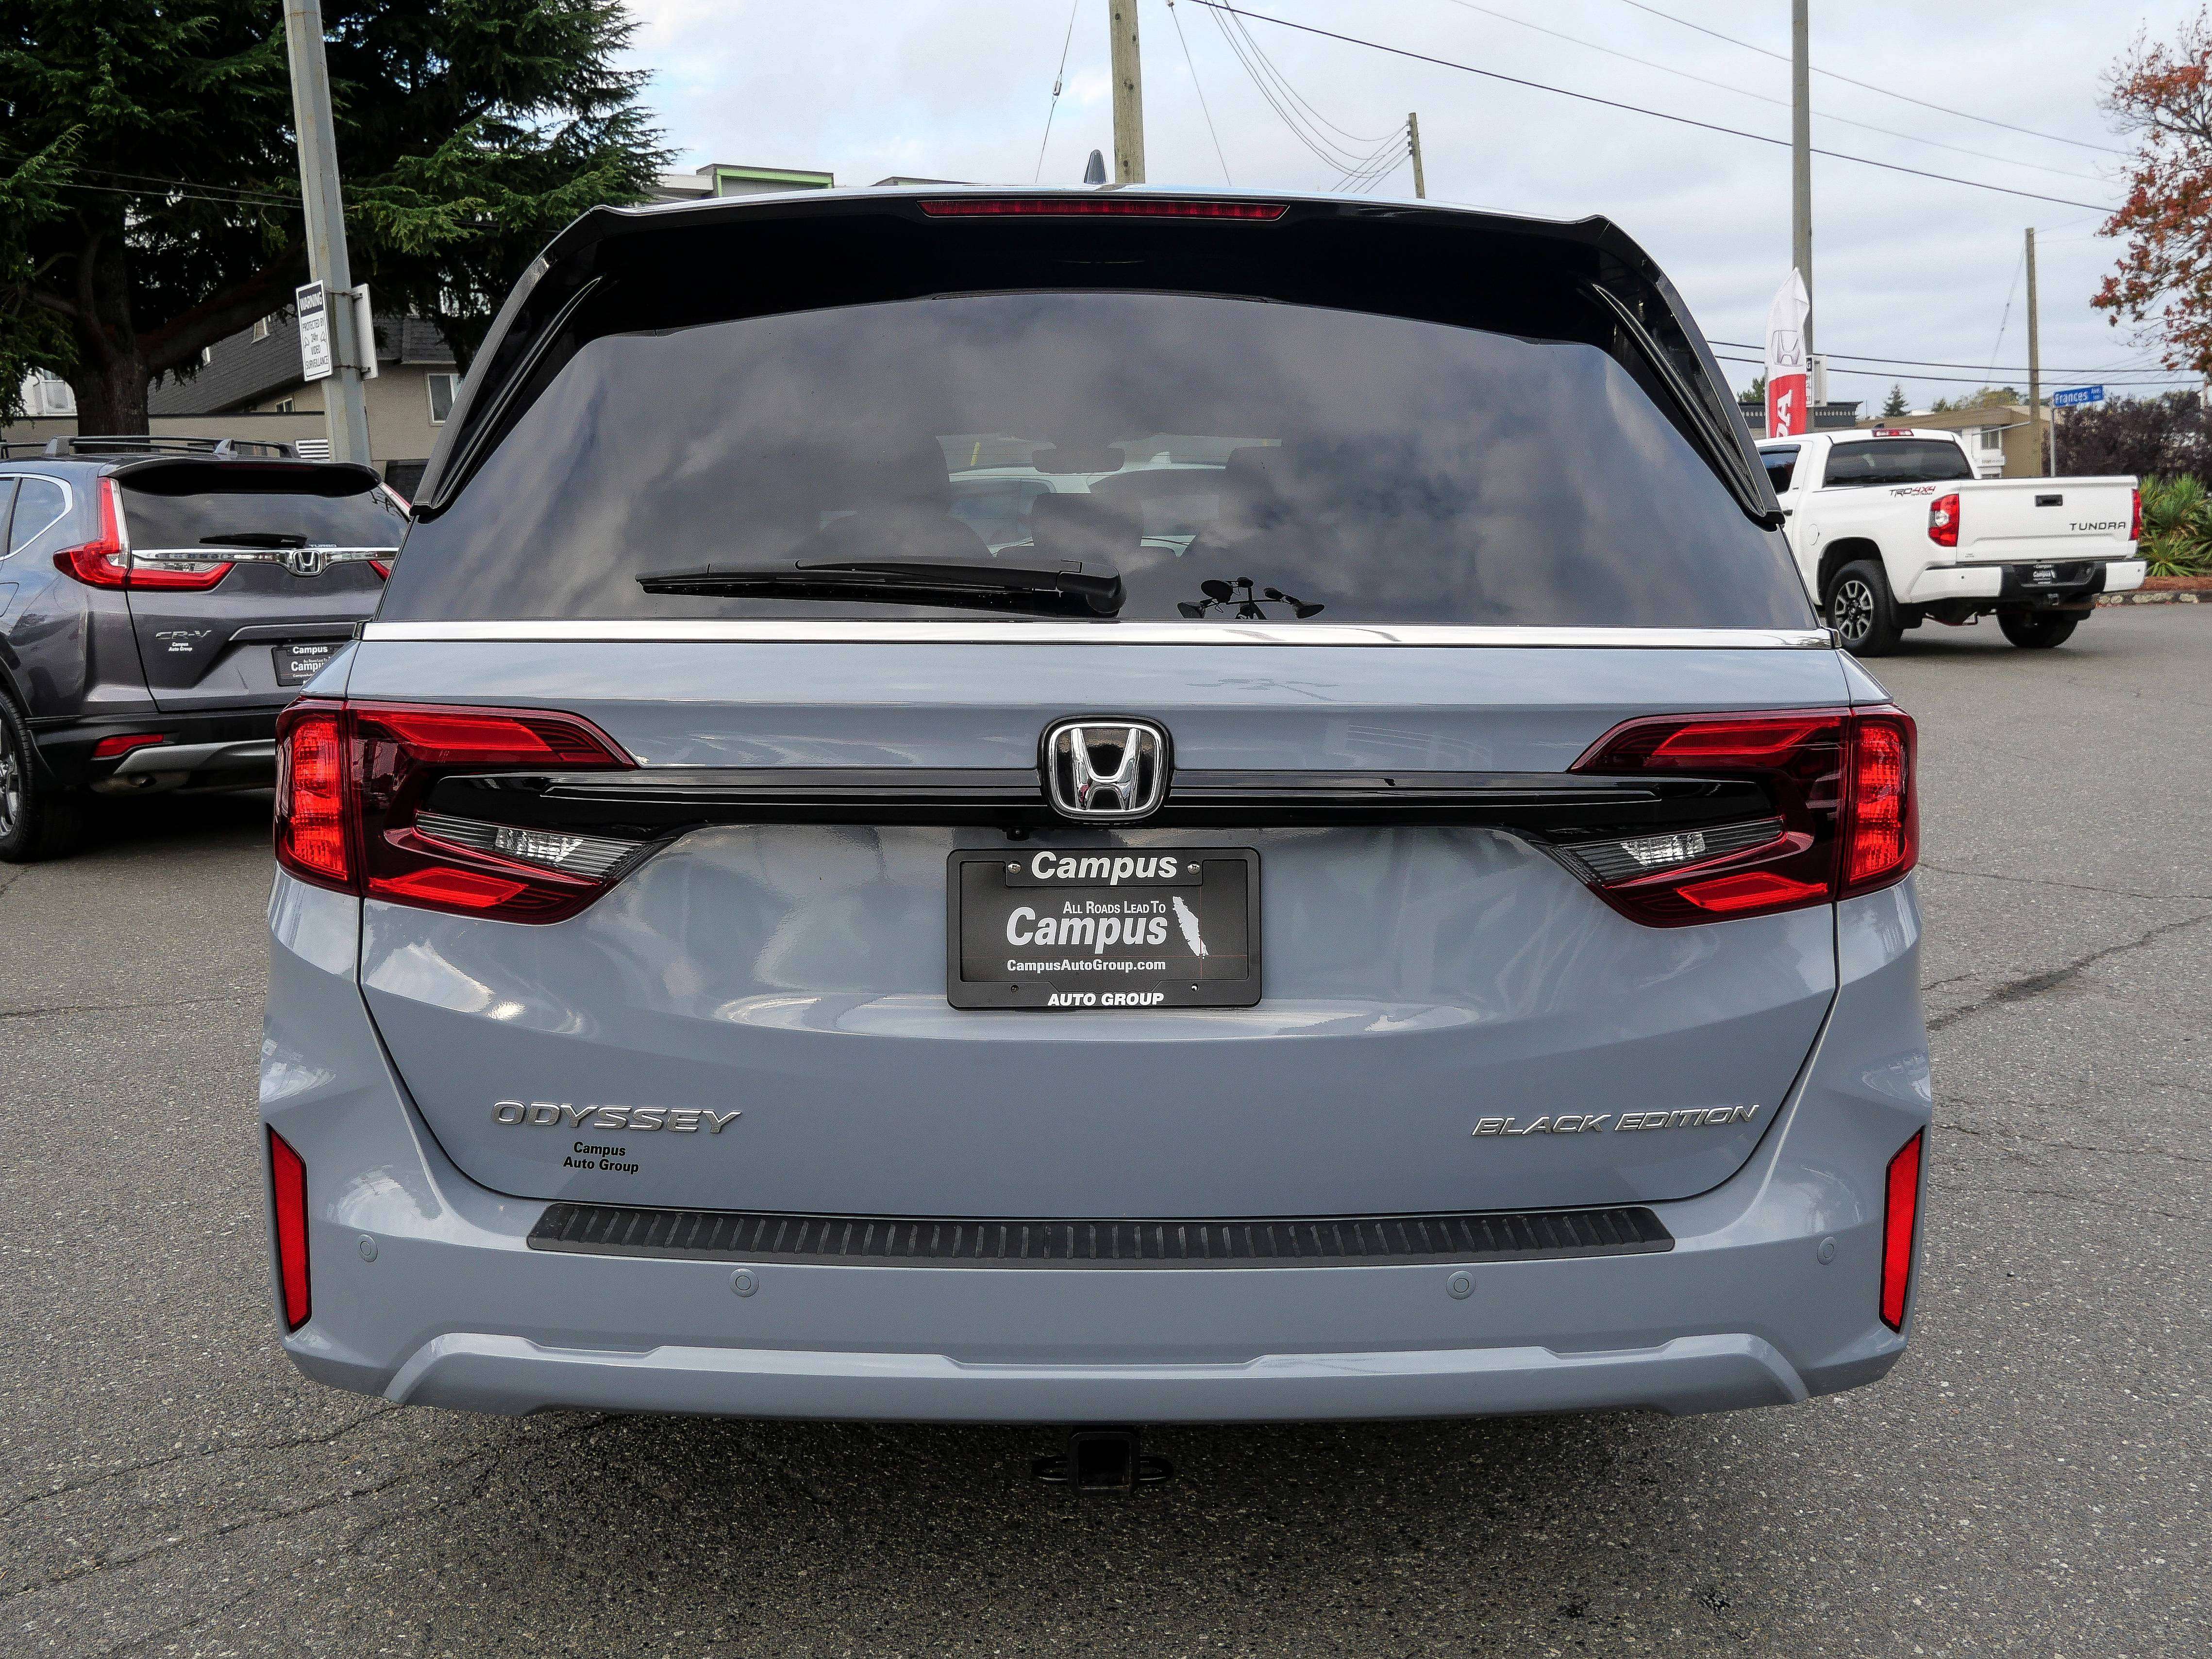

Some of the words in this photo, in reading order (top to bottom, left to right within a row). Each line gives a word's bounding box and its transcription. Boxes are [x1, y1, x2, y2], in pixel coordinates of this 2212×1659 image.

[300, 291, 322, 311] WARNING
[306, 356, 329, 370] SURVEILLANCE
[2055, 391, 2088, 404] Frances
[1889, 487, 1912, 498] TRD
[2069, 522, 2126, 531] TUNDRA
[155, 630, 212, 639] CR-V
[293, 646, 328, 655] Campus
[291, 661, 324, 672] Campu
[1031, 851, 1177, 885] Campus
[1062, 901, 1083, 914] ALL
[1086, 901, 1121, 914] ROADS
[1124, 901, 1150, 914] LEAD
[1006, 907, 1168, 955] Campus
[1007, 959, 1166, 973] CampusAutoGroup.com
[1047, 993, 1096, 1006] AUTO
[1101, 992, 1165, 1006] GROUP
[491, 1100, 742, 1134] ODYSSEY
[1472, 1113, 1612, 1137] BLACK
[1614, 1105, 1760, 1131] EDITION
[573, 1141, 626, 1157] Campus
[563, 1156, 595, 1171] Auto
[599, 1158, 639, 1175] Group
